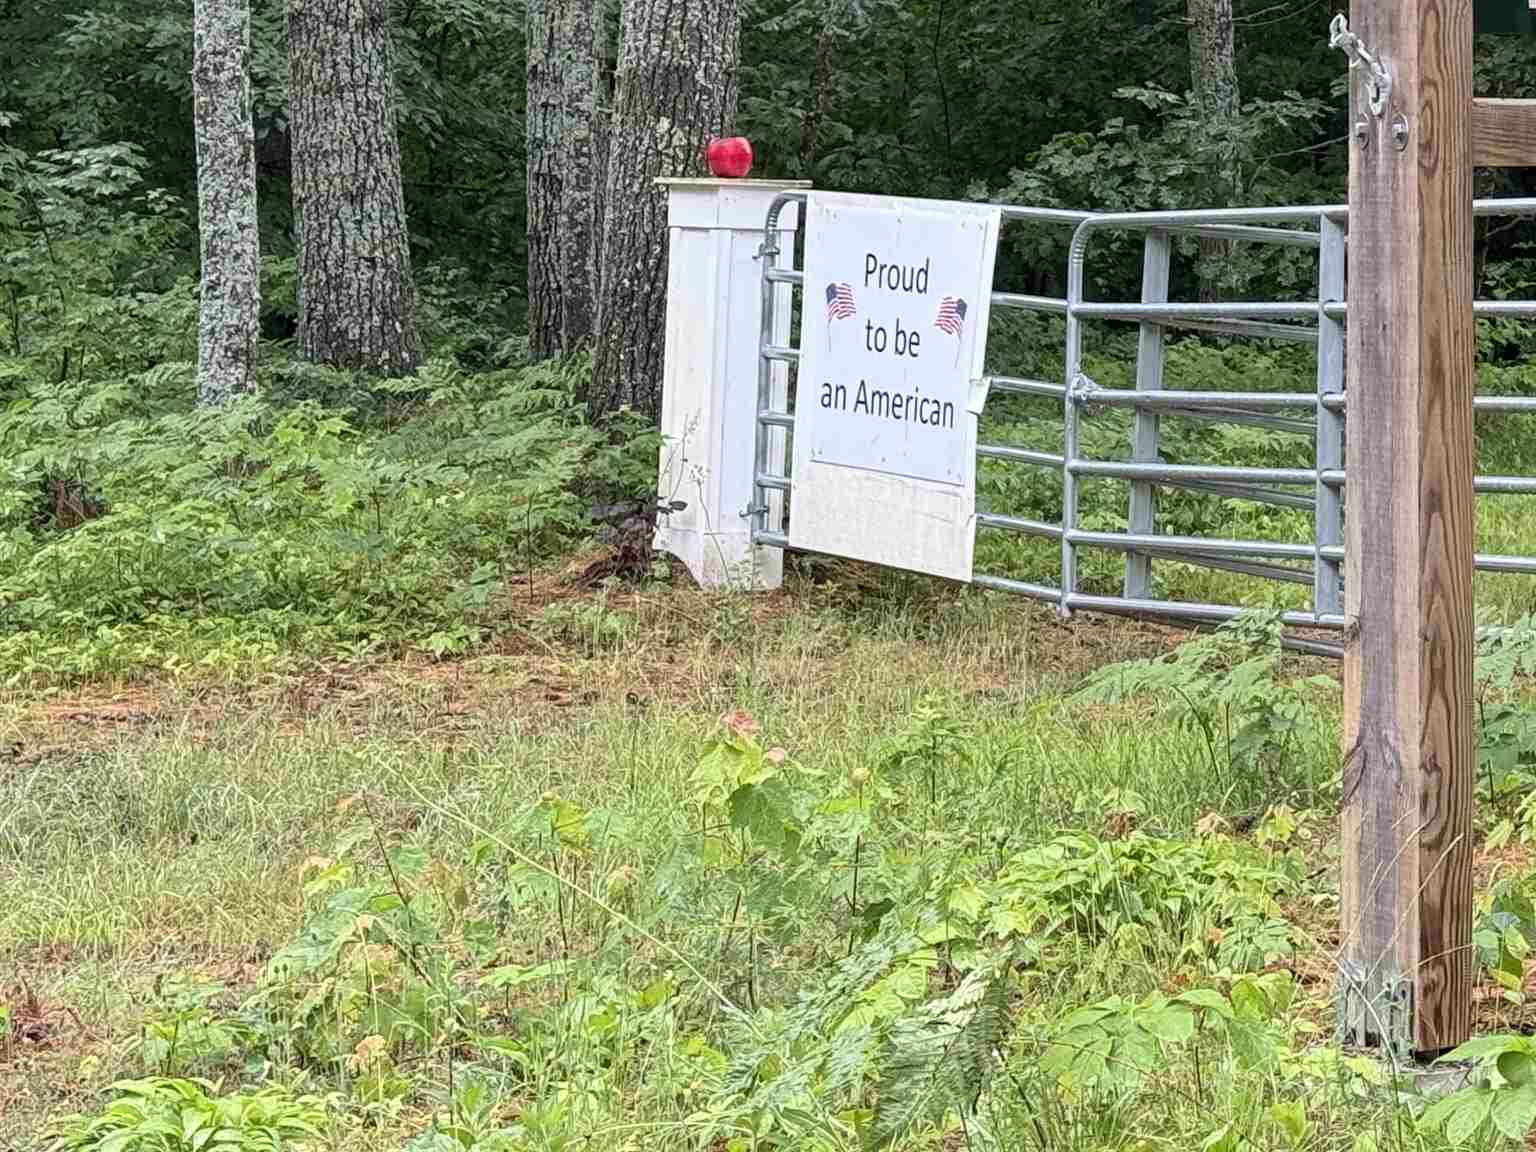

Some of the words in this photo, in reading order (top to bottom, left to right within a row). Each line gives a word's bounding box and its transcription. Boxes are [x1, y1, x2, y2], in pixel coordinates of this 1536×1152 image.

[864, 252, 930, 295] Proud
[865, 319, 888, 353] to
[894, 317, 921, 358] be
[820, 382, 847, 411] an
[853, 379, 954, 429] American
